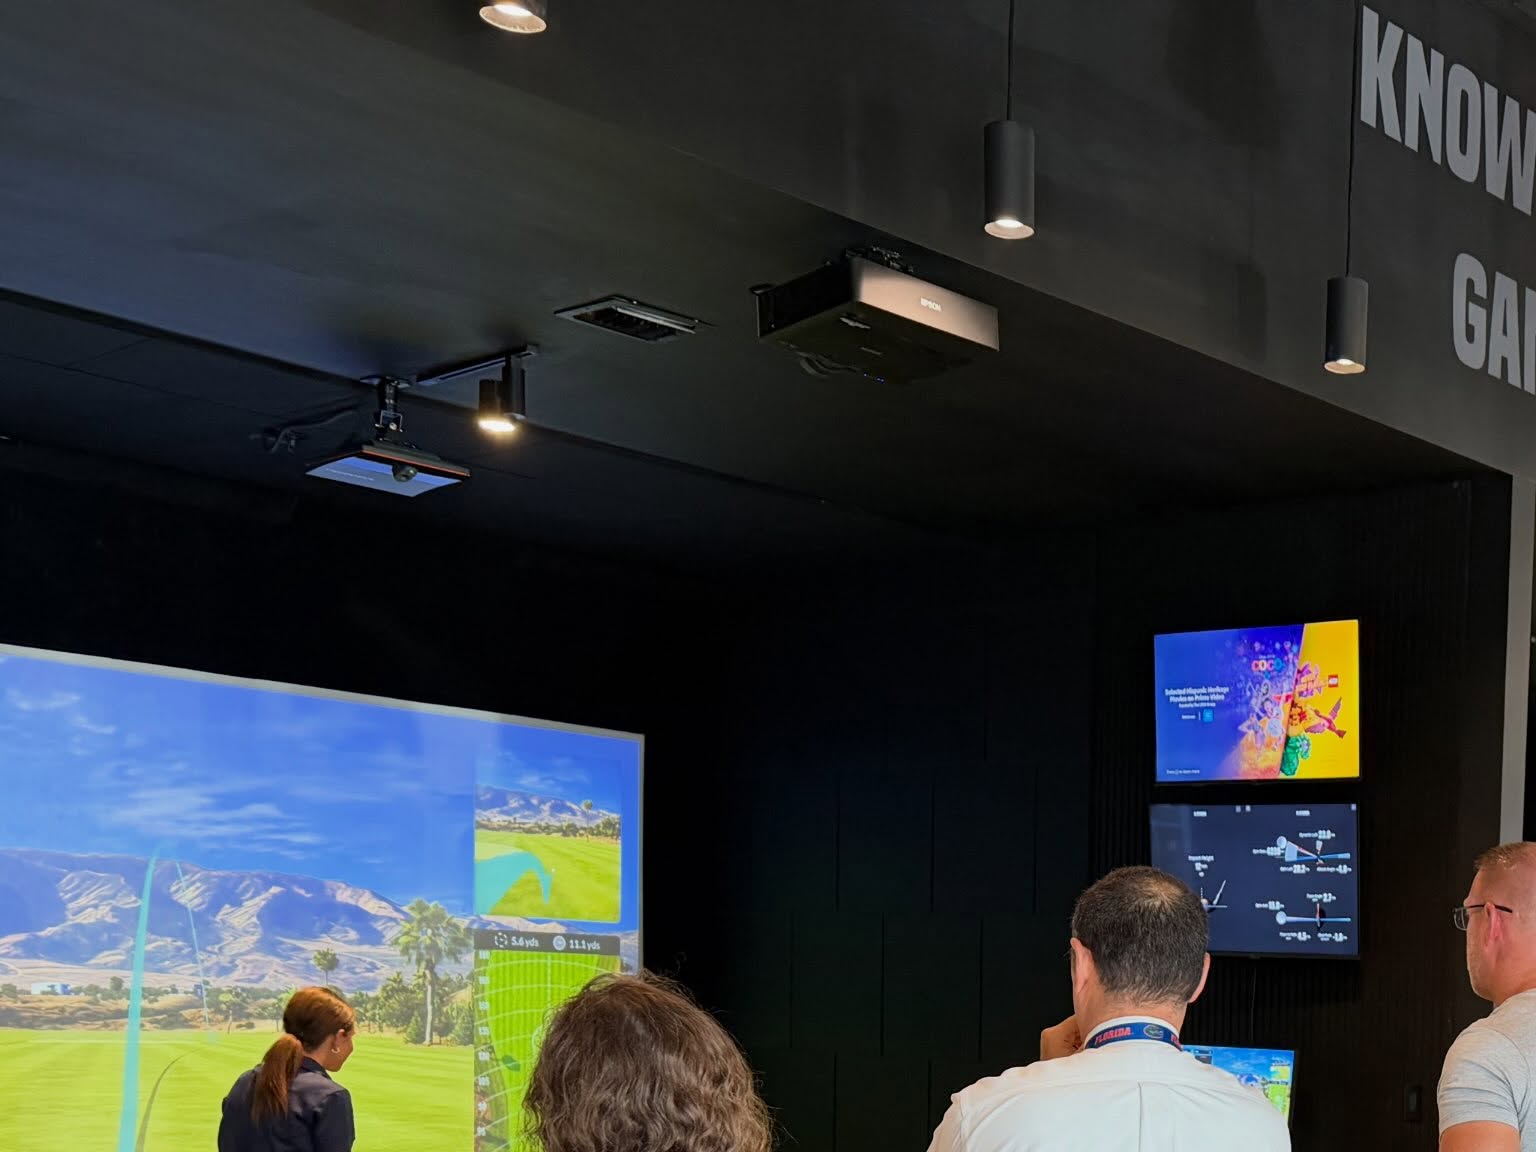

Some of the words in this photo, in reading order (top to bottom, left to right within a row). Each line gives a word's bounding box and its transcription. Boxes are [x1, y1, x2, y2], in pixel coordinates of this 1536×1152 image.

[525, 936, 539, 948] yds
[586, 940, 601, 951] yds
[1094, 1026, 1131, 1045] FLORIDA
